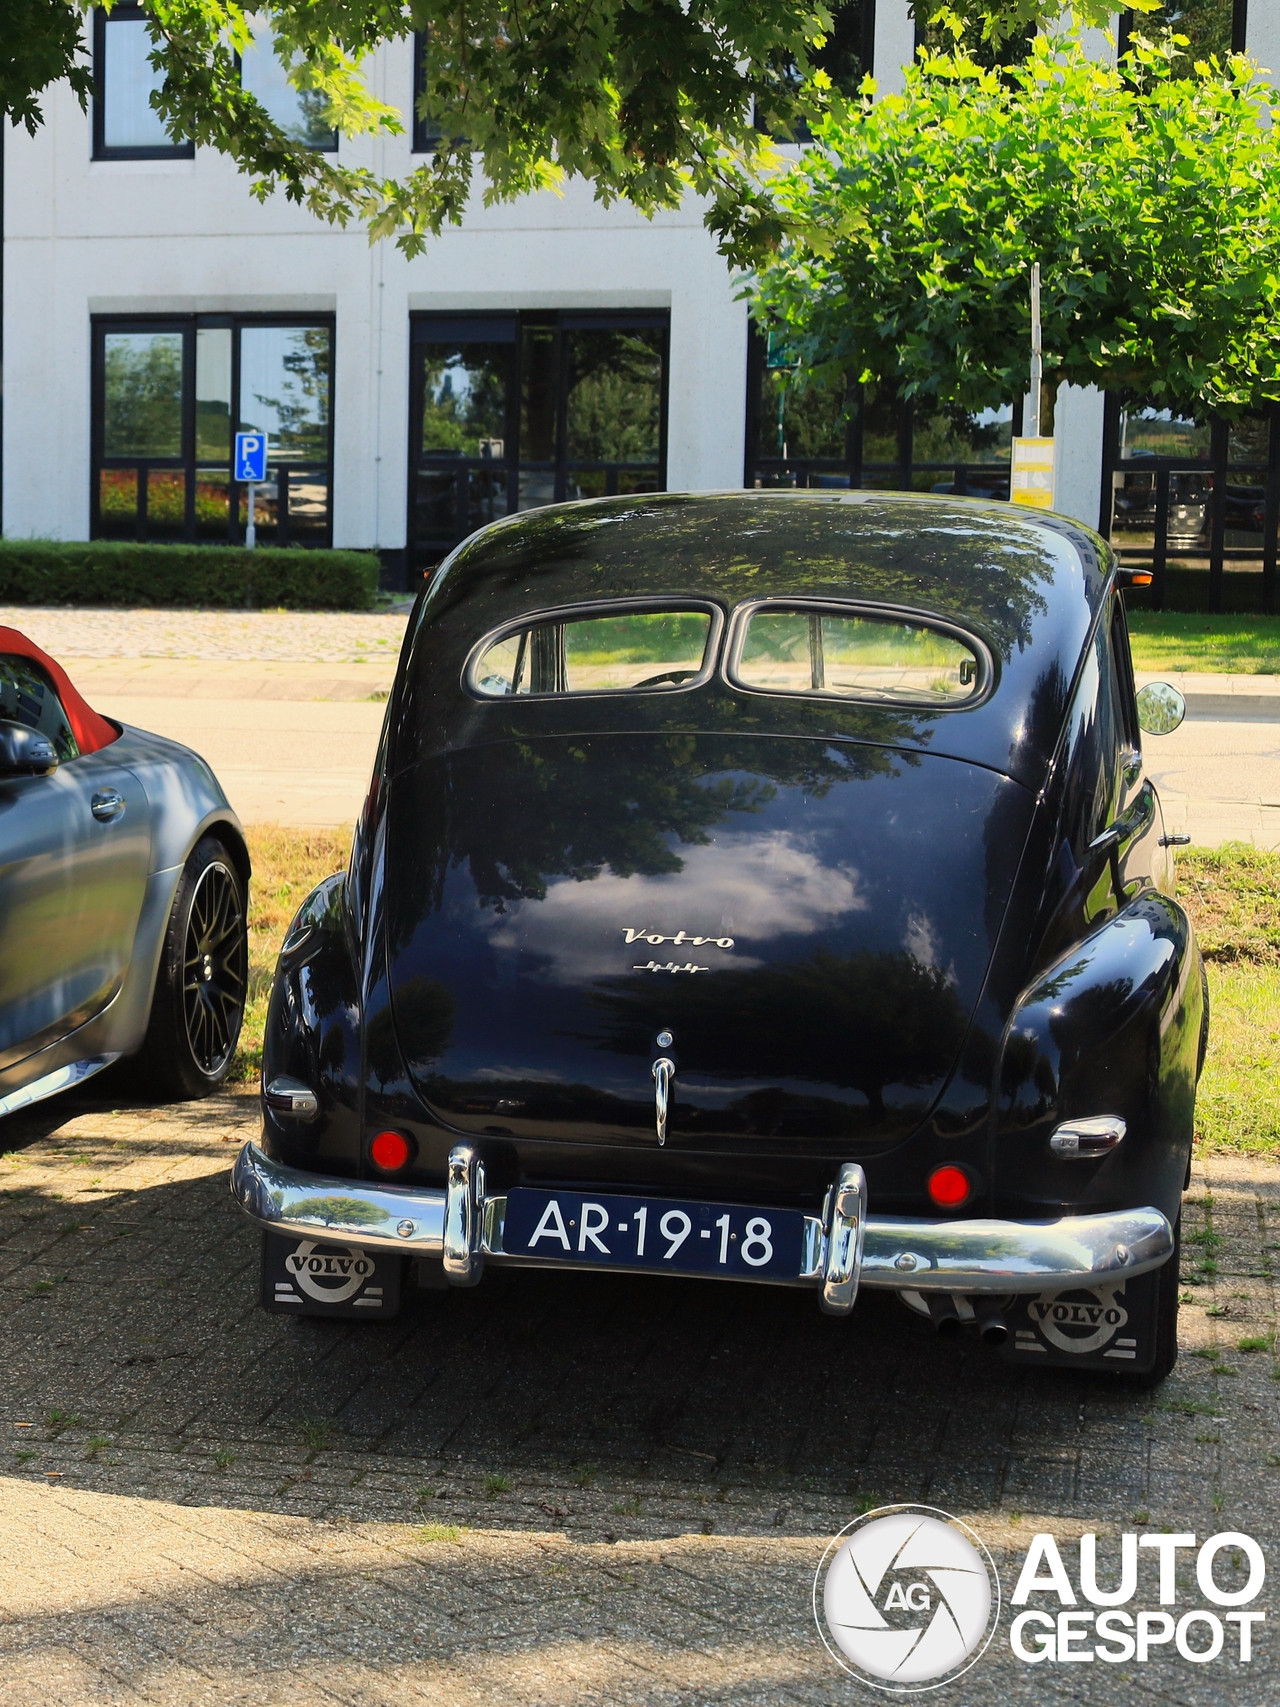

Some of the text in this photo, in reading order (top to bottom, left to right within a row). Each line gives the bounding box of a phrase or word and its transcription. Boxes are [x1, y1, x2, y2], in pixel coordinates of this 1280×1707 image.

[242, 437, 260, 461] P
[621, 927, 735, 948] Volvo
[633, 960, 709, 973] 444
[527, 1200, 773, 1266] AR-19-18
[291, 1256, 369, 1275] VOLVO
[1034, 1302, 1121, 1325] VOLVO
